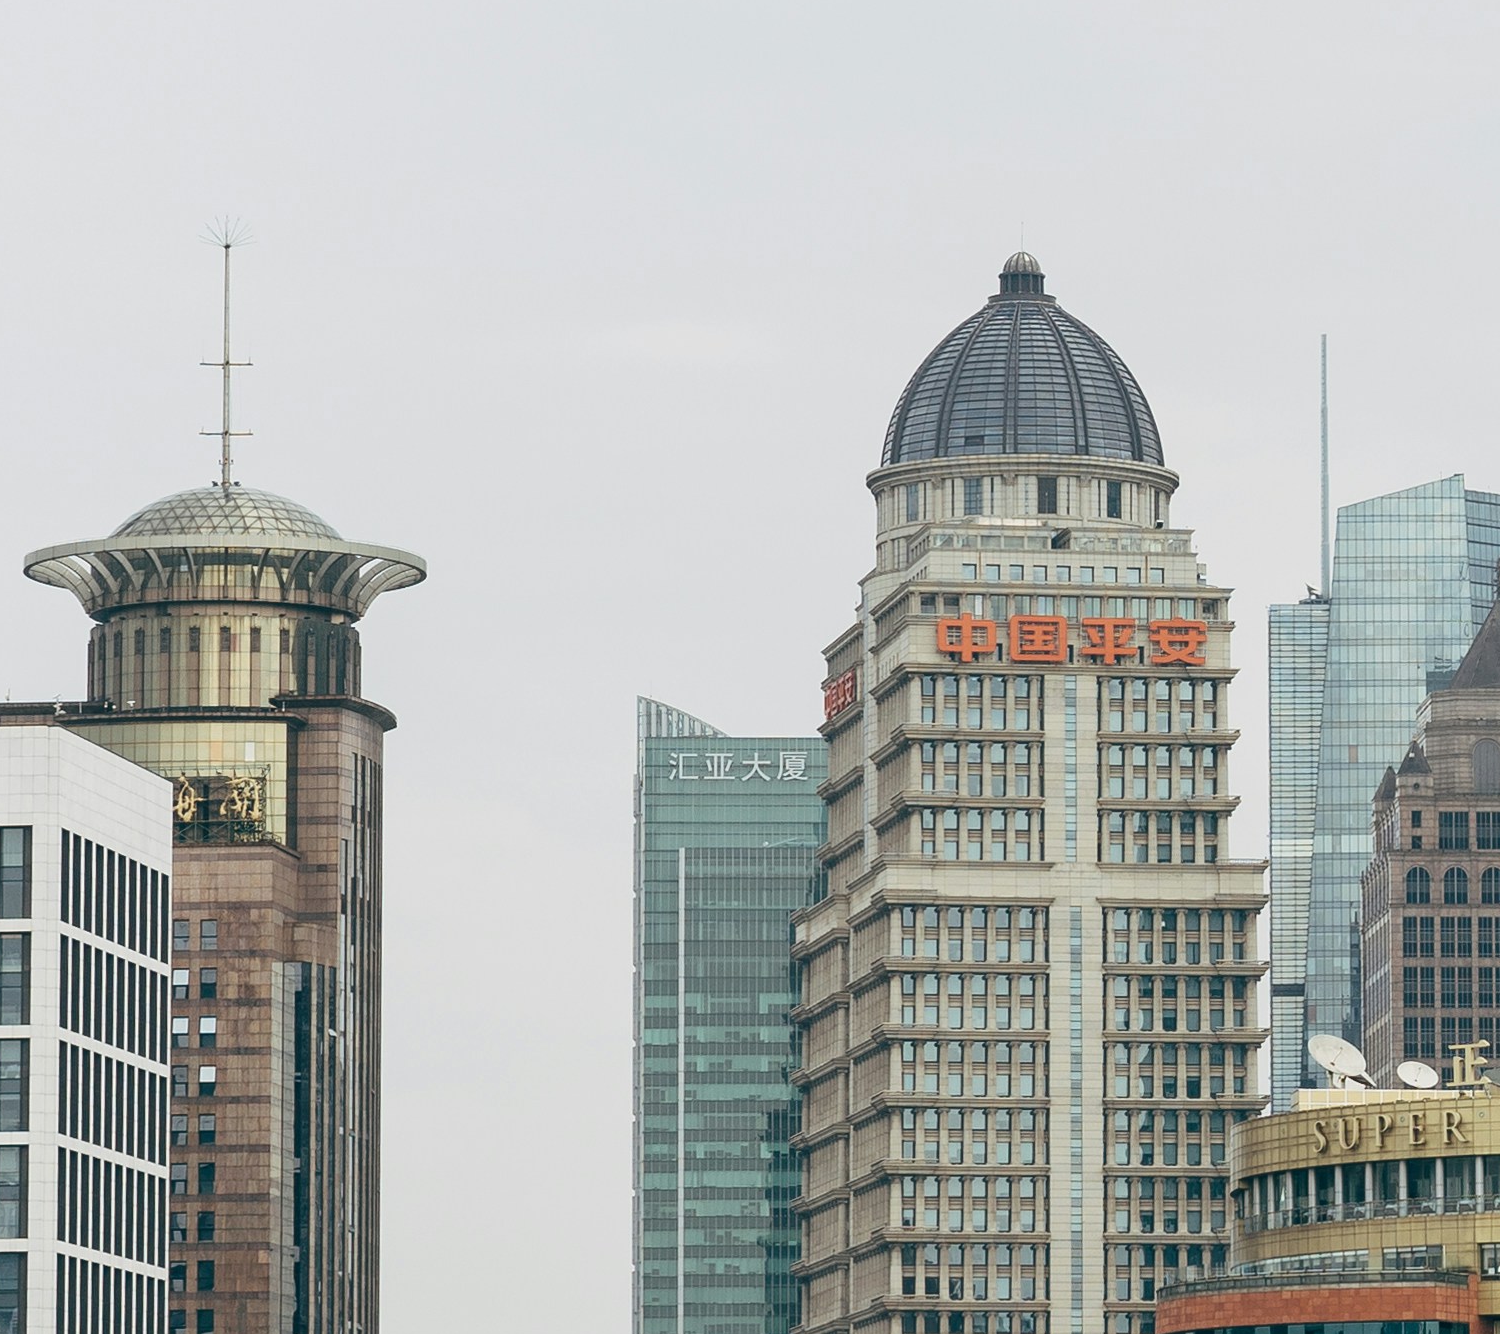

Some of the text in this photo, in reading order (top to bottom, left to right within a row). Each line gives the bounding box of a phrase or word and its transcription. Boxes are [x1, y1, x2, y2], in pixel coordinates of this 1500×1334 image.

[937, 612, 1208, 666] 中国平安
[668, 751, 809, 782] 汇亚大厦
[1313, 1110, 1470, 1154] SUPER
